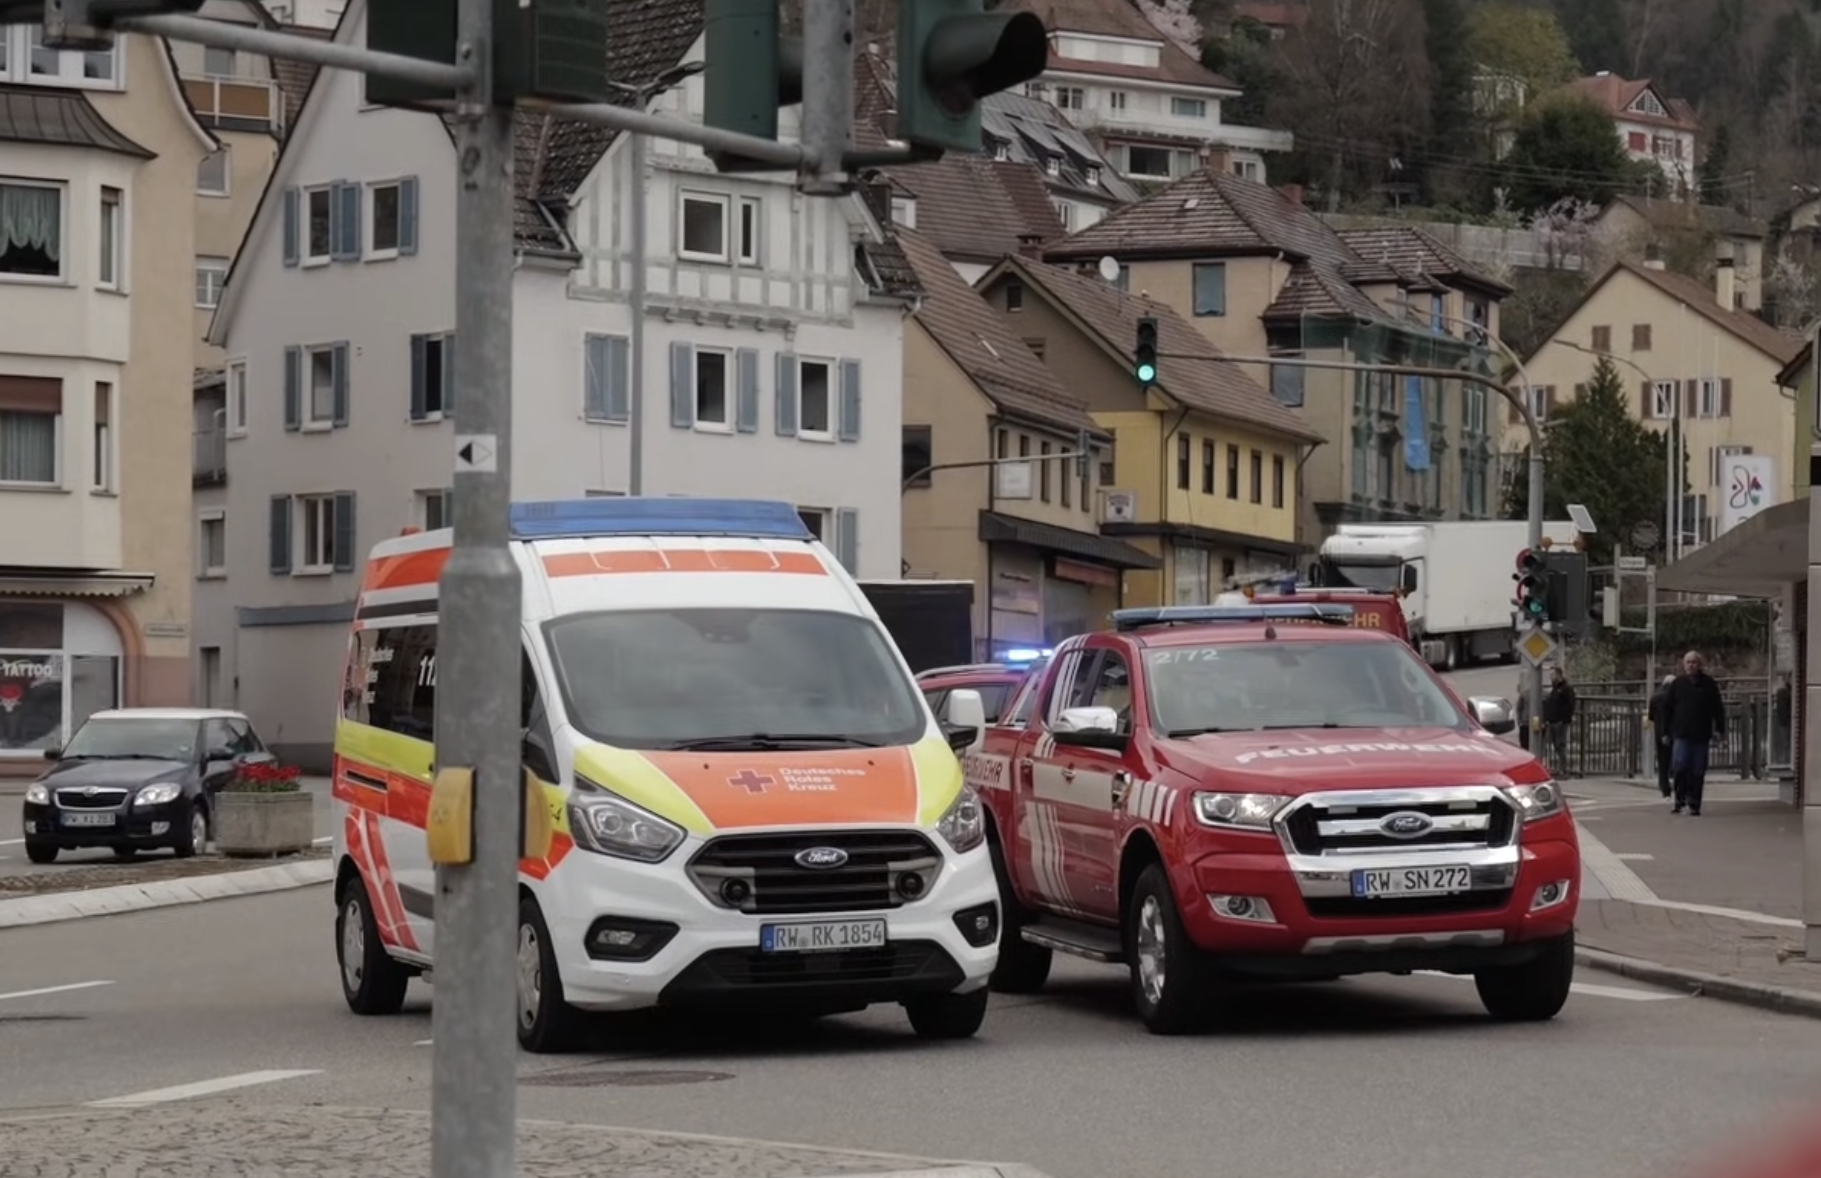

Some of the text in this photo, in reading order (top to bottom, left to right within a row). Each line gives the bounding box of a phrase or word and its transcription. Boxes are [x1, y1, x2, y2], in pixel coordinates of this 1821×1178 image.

[4, 663, 52, 678] TATTOO
[418, 655, 436, 686] 11
[1235, 739, 1502, 764] FEUERWEHR
[779, 767, 866, 777] Deutsches
[788, 783, 837, 791] Kreuz
[807, 851, 838, 864] Ford
[1365, 867, 1469, 892] RW SN 272
[776, 923, 883, 948] RW RK 1854
